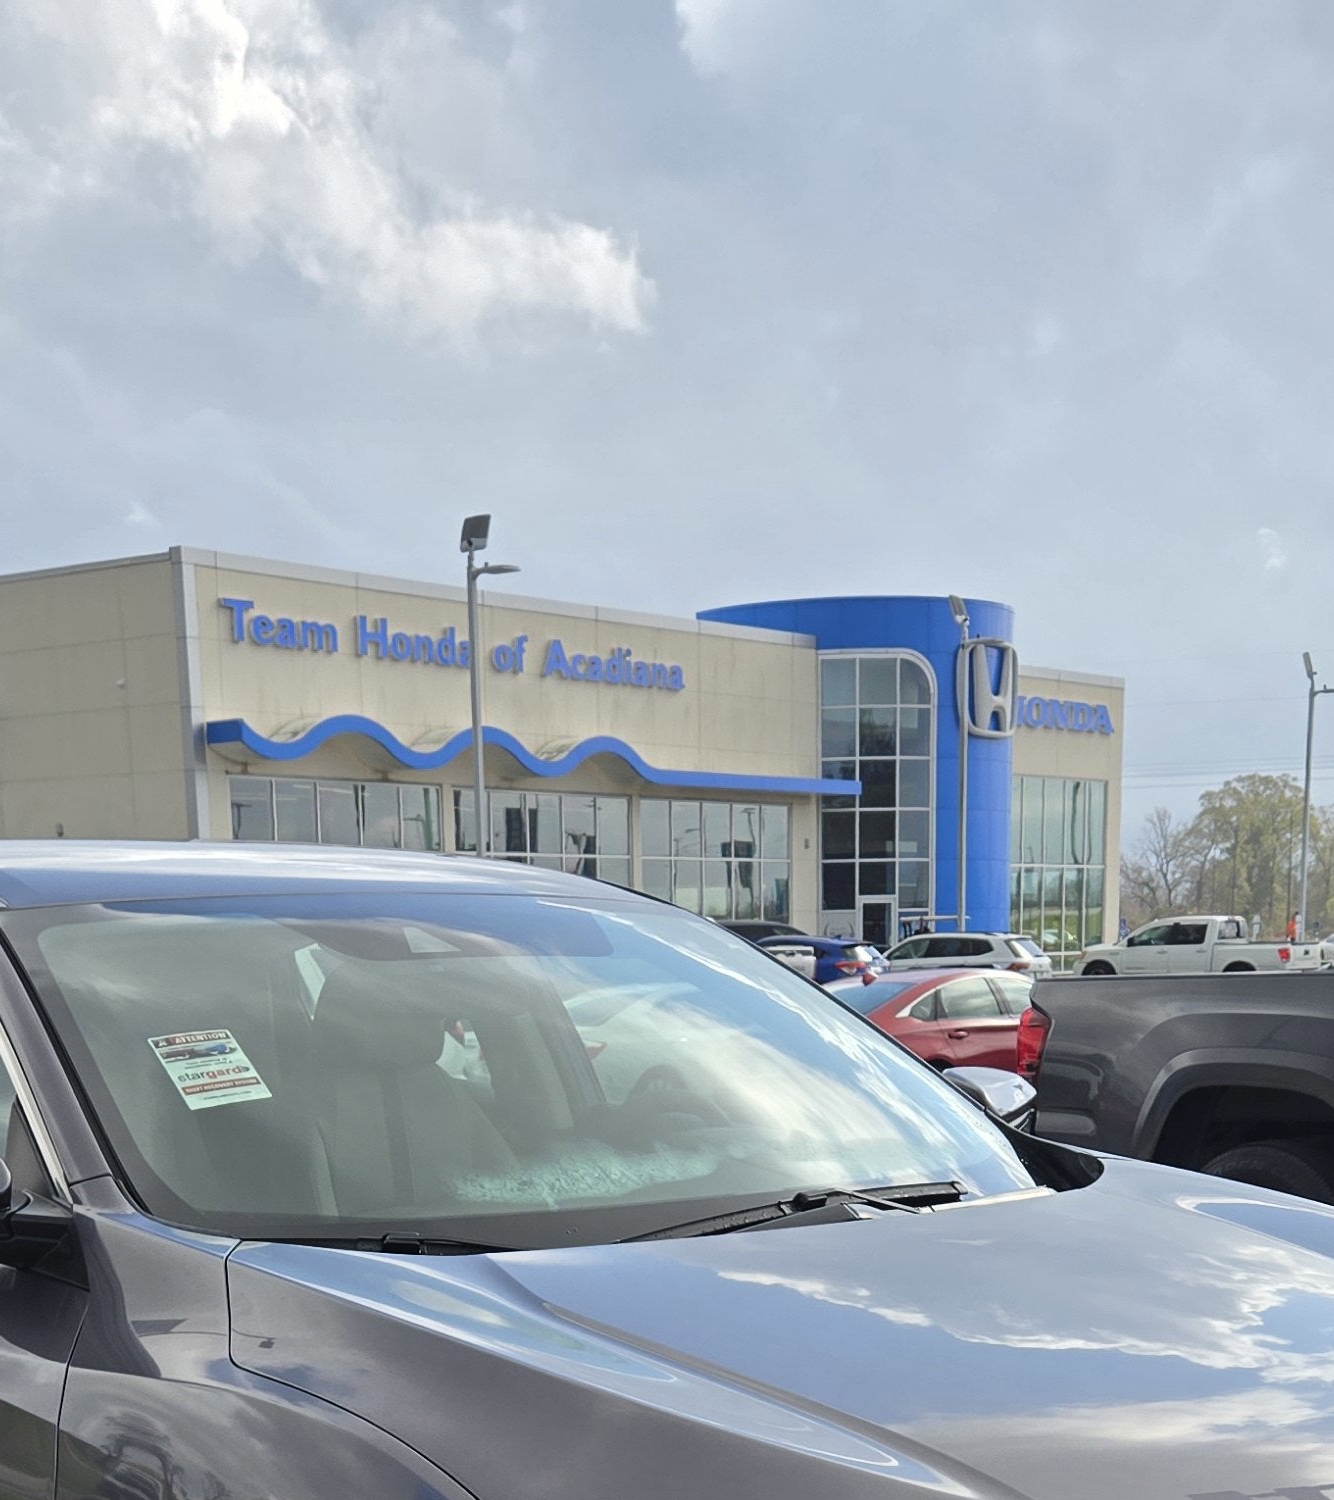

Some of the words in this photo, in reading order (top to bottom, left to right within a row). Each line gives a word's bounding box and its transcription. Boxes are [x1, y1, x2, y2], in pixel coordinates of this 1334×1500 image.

[219, 597, 338, 653] Team
[356, 614, 470, 670] Honda
[493, 634, 528, 674] of
[540, 637, 686, 692] Acadiana
[175, 1032, 227, 1044] ATTENTION
